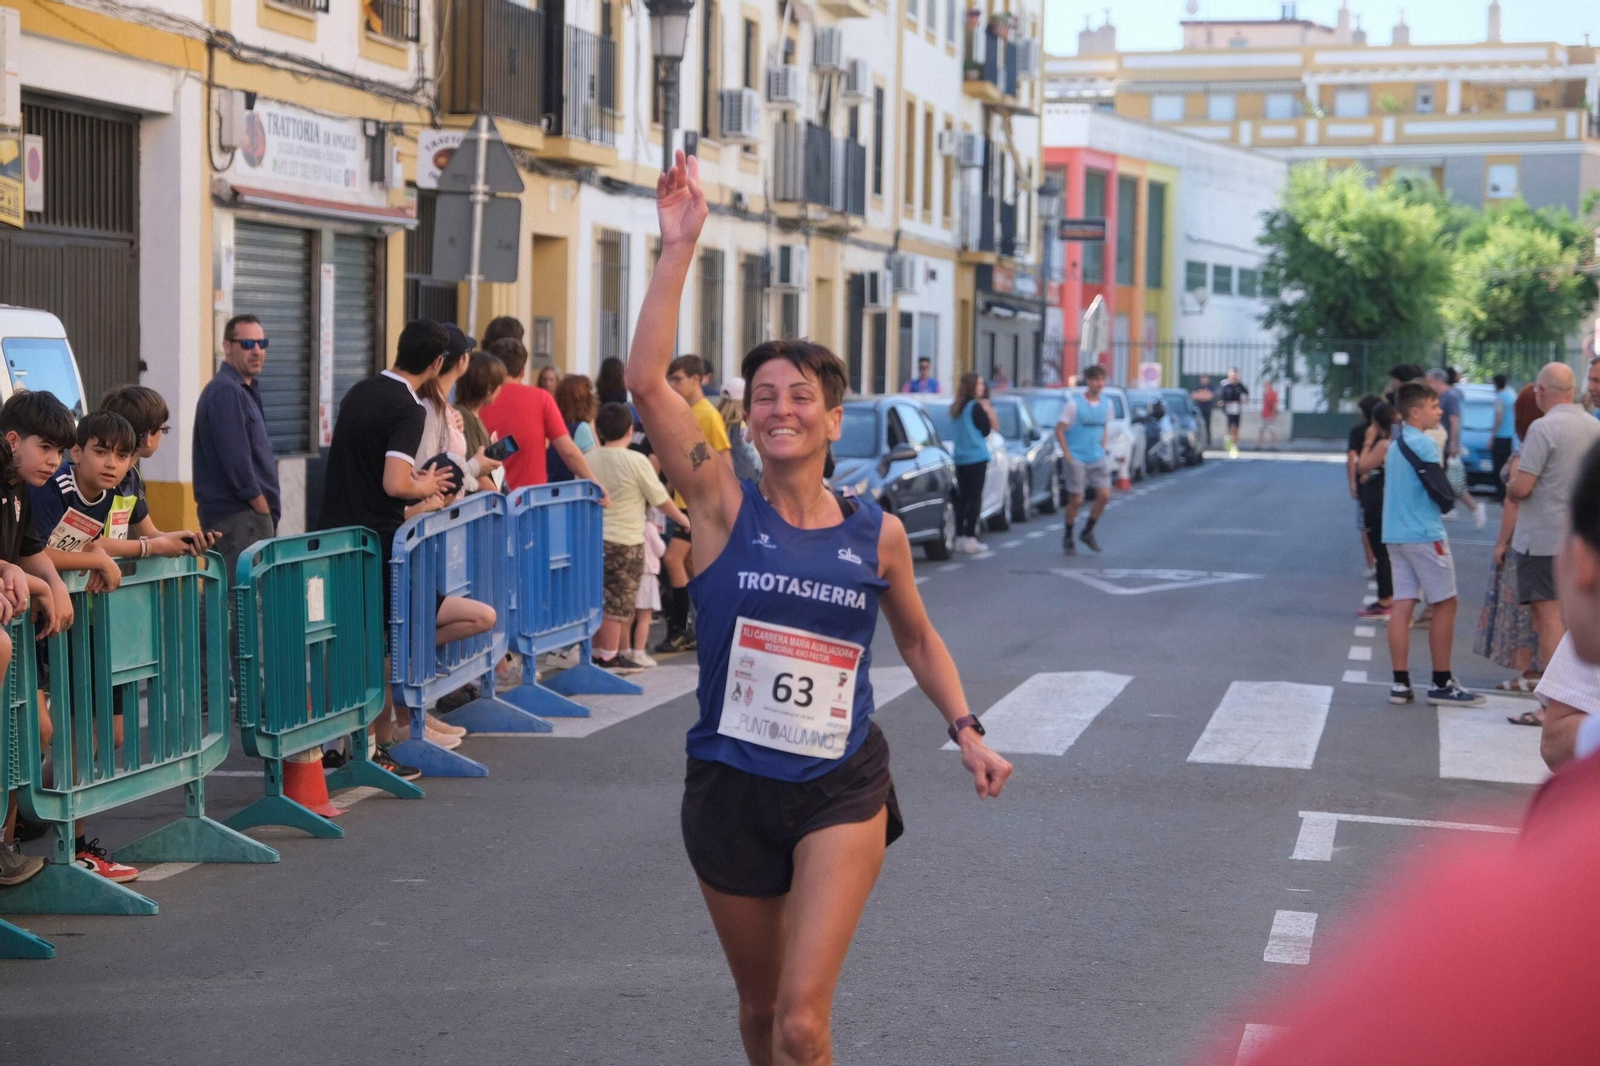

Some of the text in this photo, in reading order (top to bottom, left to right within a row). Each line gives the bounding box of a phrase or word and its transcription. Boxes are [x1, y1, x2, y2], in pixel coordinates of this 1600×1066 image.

[267, 112, 320, 143] TRATTORIA
[57, 534, 81, 551] 620
[737, 571, 866, 610] TROTASIERRA
[742, 628, 853, 658] XLI CARRERA MARIA AUXILIADORA
[764, 643, 830, 663] MEMORIAL KIKO PASTOR
[771, 672, 814, 708] 63
